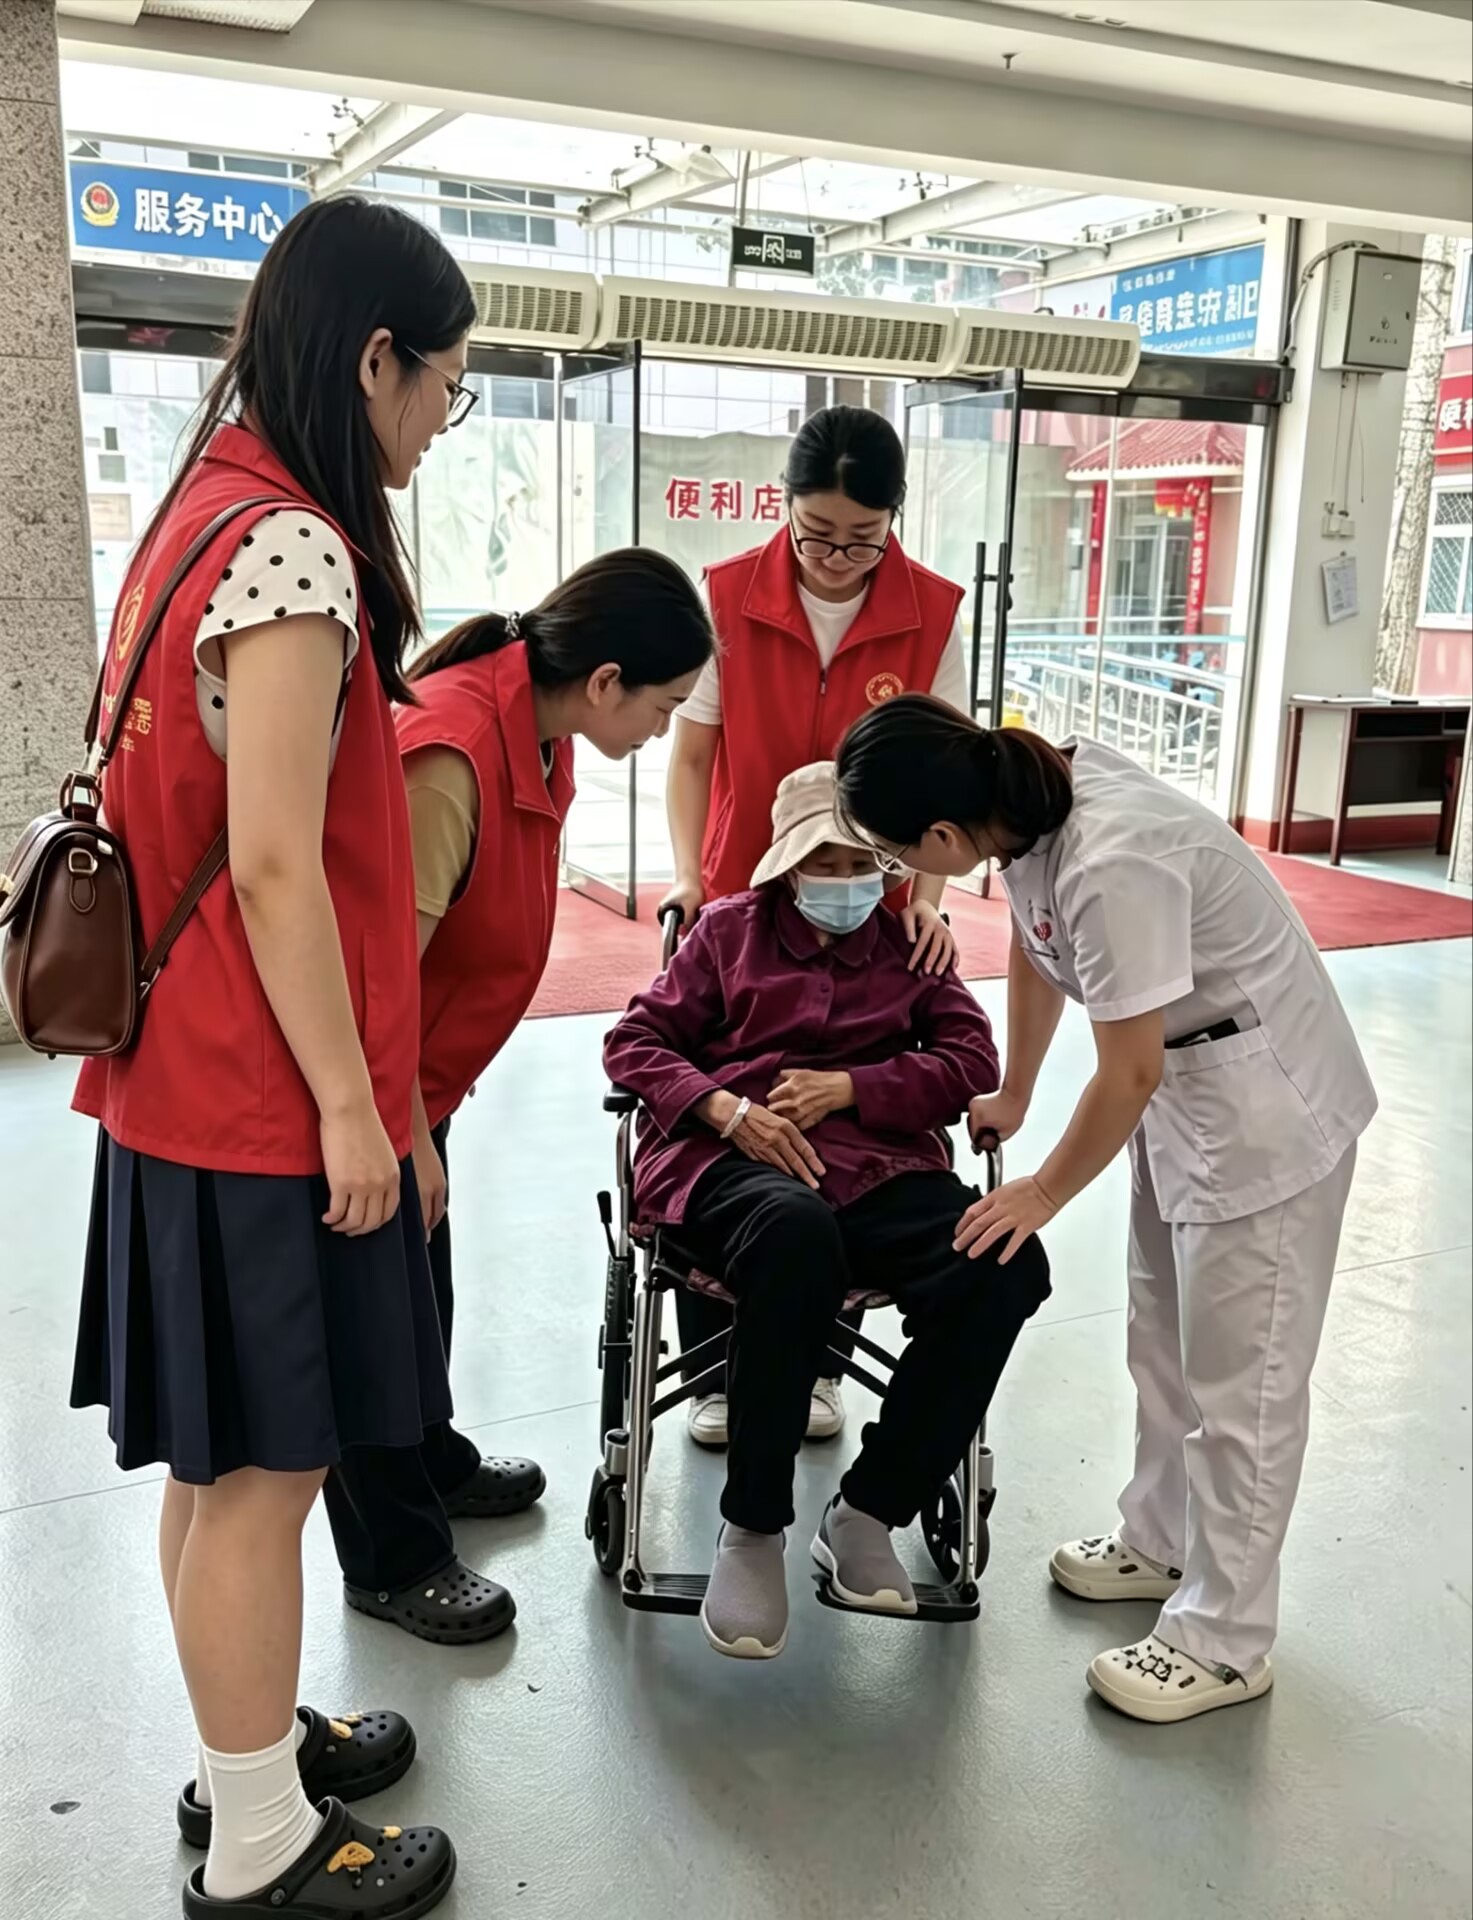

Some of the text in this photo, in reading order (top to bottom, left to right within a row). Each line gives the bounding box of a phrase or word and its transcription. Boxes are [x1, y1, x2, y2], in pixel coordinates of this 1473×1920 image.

[133, 188, 284, 244] 服务中心
[664, 477, 784, 521] 便利店
